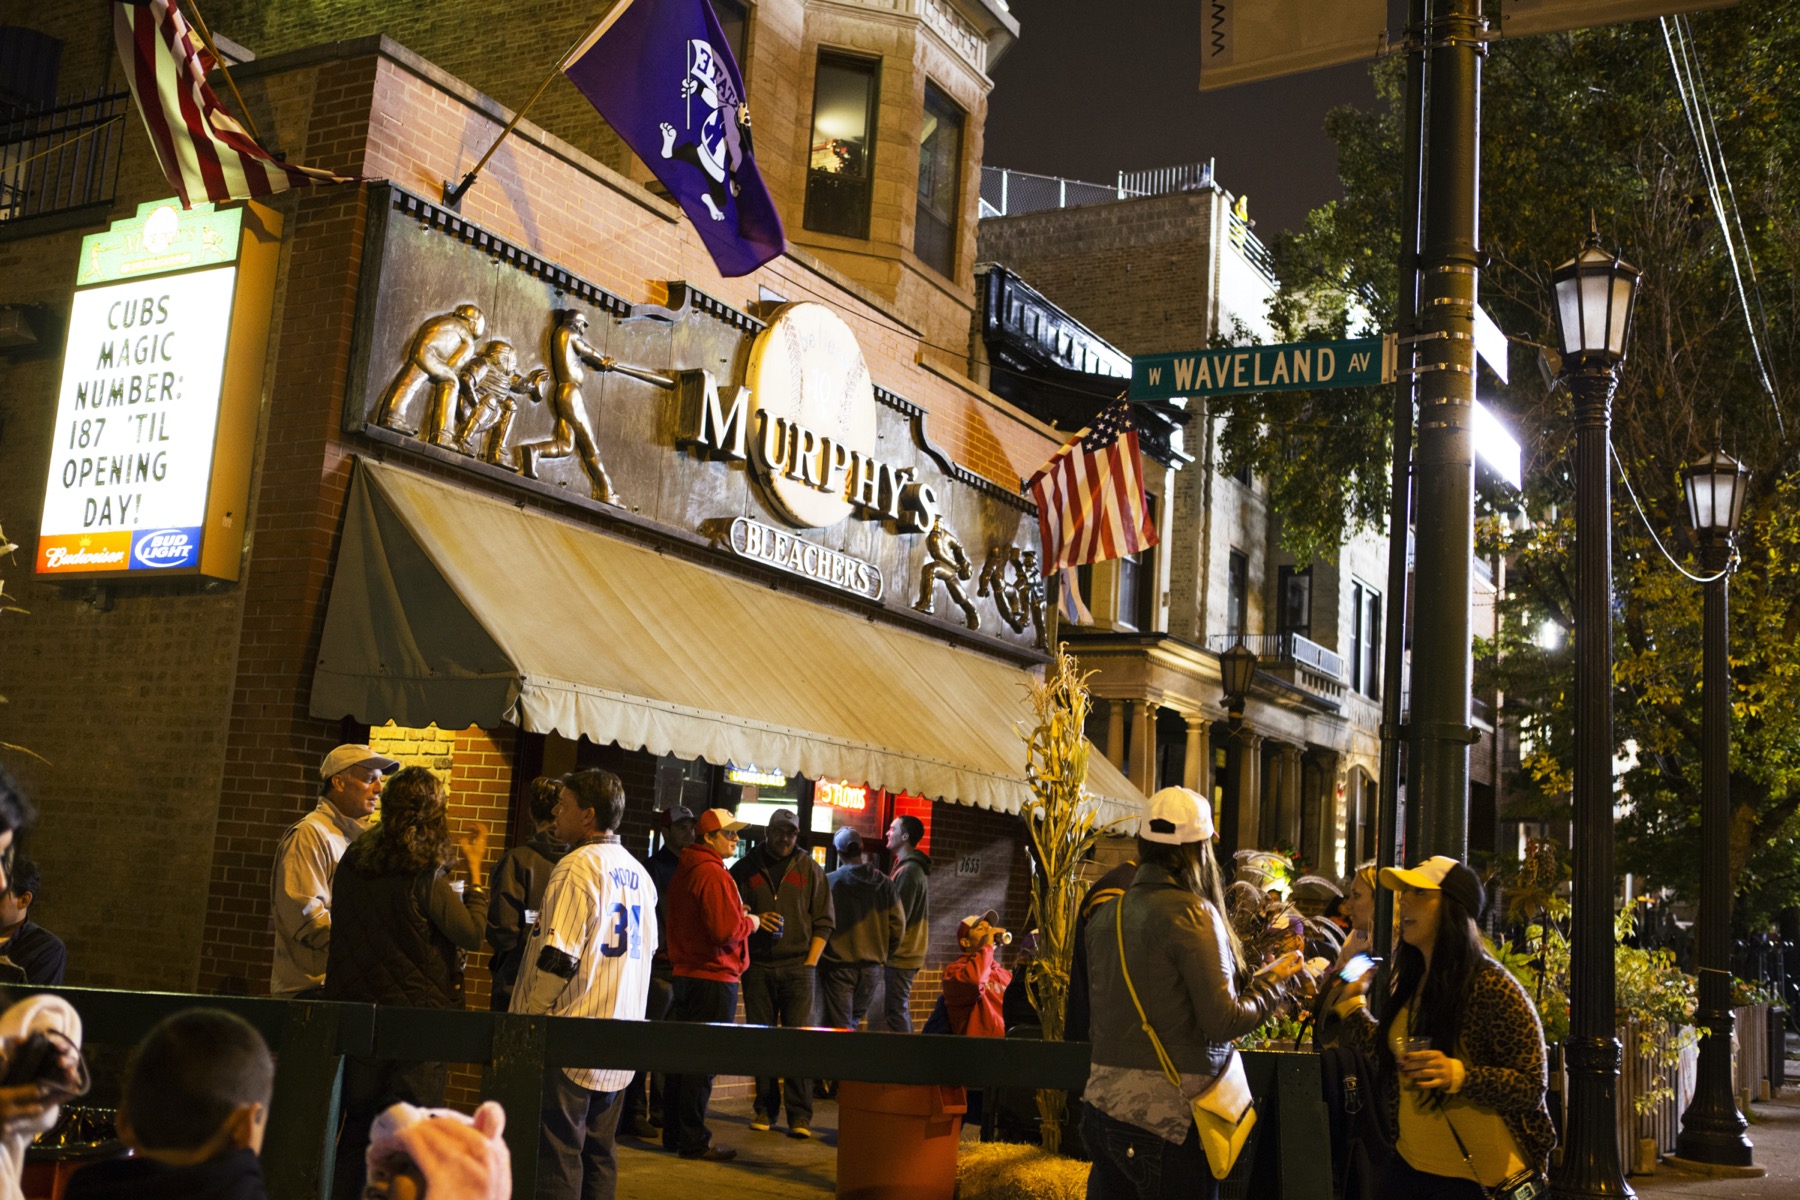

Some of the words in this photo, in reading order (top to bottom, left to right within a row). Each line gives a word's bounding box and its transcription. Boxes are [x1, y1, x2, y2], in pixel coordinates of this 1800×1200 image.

[107, 294, 170, 331] CUBS
[96, 331, 175, 371] MAGIC
[1148, 367, 1162, 386] W
[1173, 347, 1336, 391] WAVELAND
[1347, 352, 1371, 373] AV
[74, 371, 184, 411] NUMBER:
[69, 417, 107, 450] 187
[128, 411, 170, 443] 'TIL
[62, 450, 167, 489] OPENING
[697, 367, 938, 534] MURPHY'S
[83, 493, 142, 528] DAY!
[45, 546, 125, 568] Budweiser
[140, 545, 193, 559] LIGHT
[150, 534, 189, 548] BUD
[744, 521, 871, 595] BLEACHERS
[608, 867, 640, 891] WOOD
[959, 856, 980, 874] 3655
